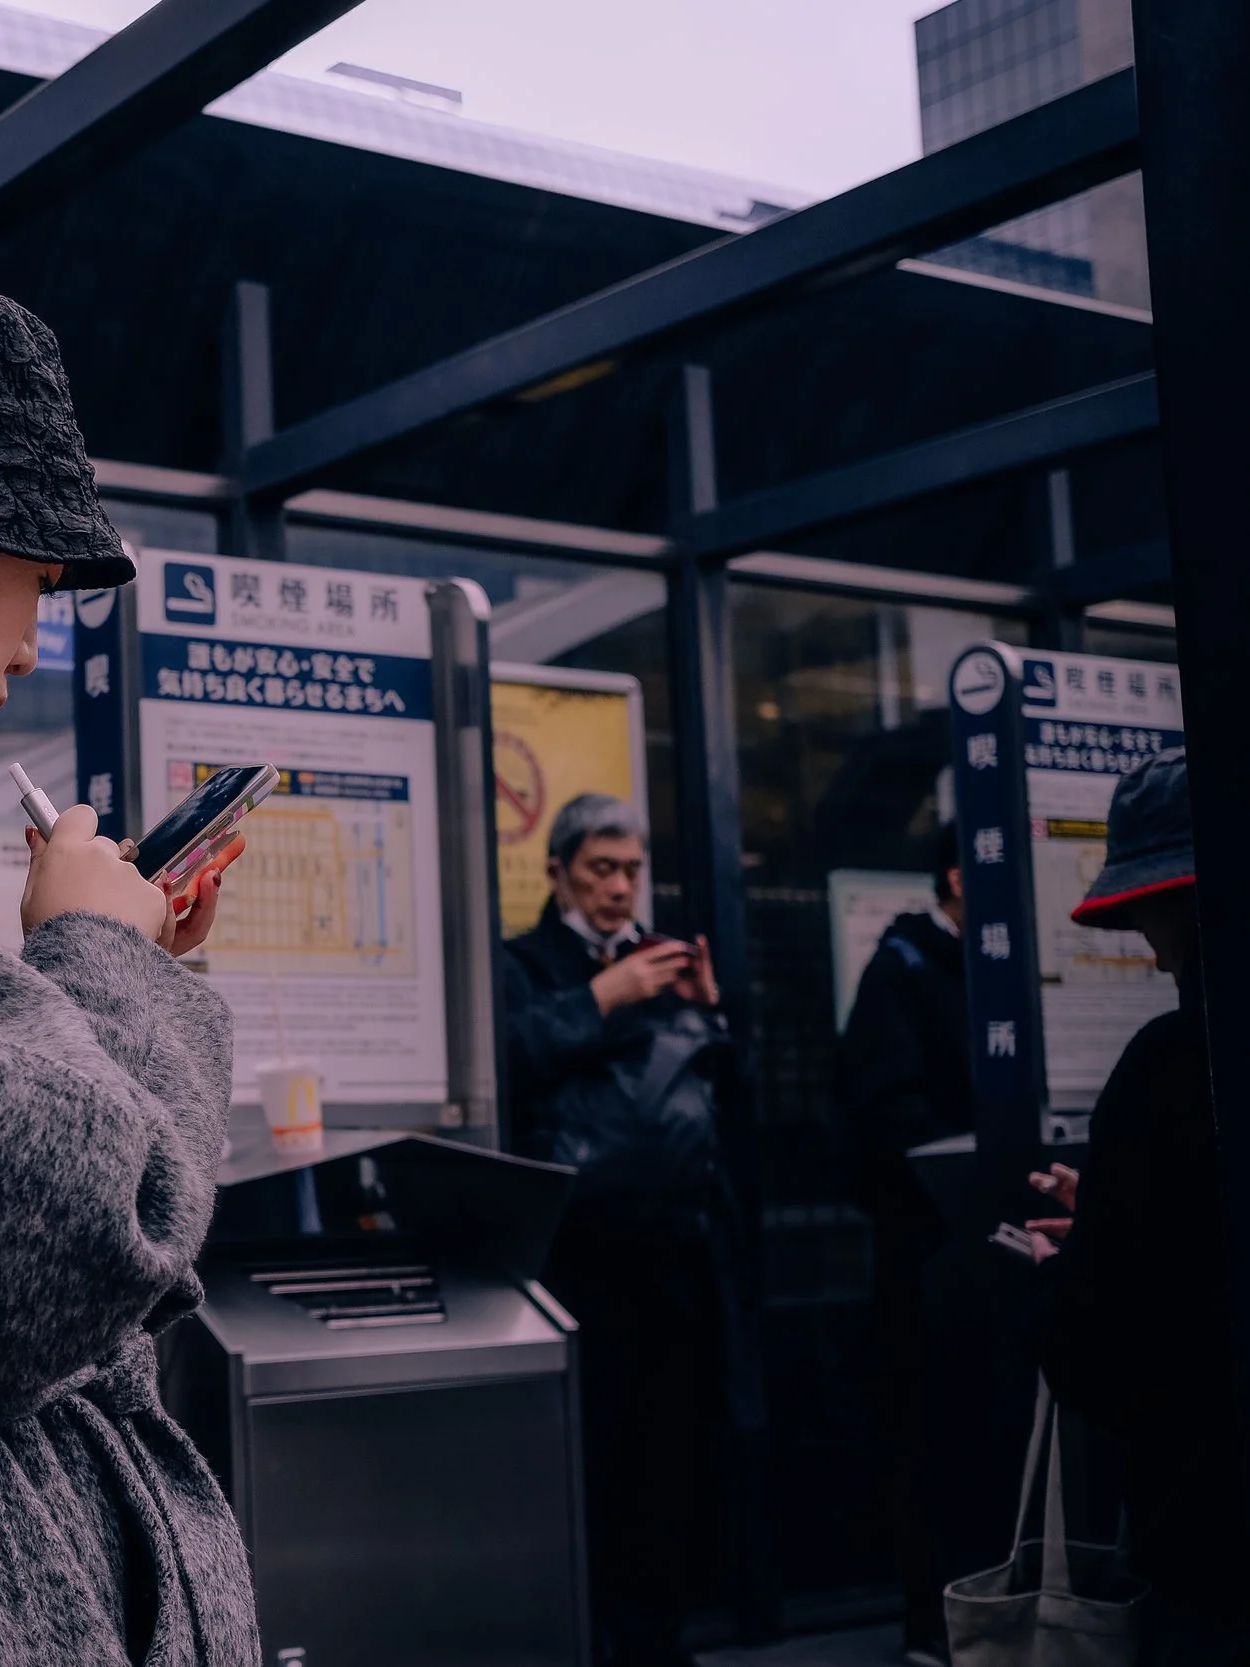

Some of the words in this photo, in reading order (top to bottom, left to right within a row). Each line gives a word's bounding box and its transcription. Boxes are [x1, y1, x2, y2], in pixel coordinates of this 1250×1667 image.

[230, 572, 400, 625] 喫煙場所
[966, 732, 1016, 1058] 喫煙場所
